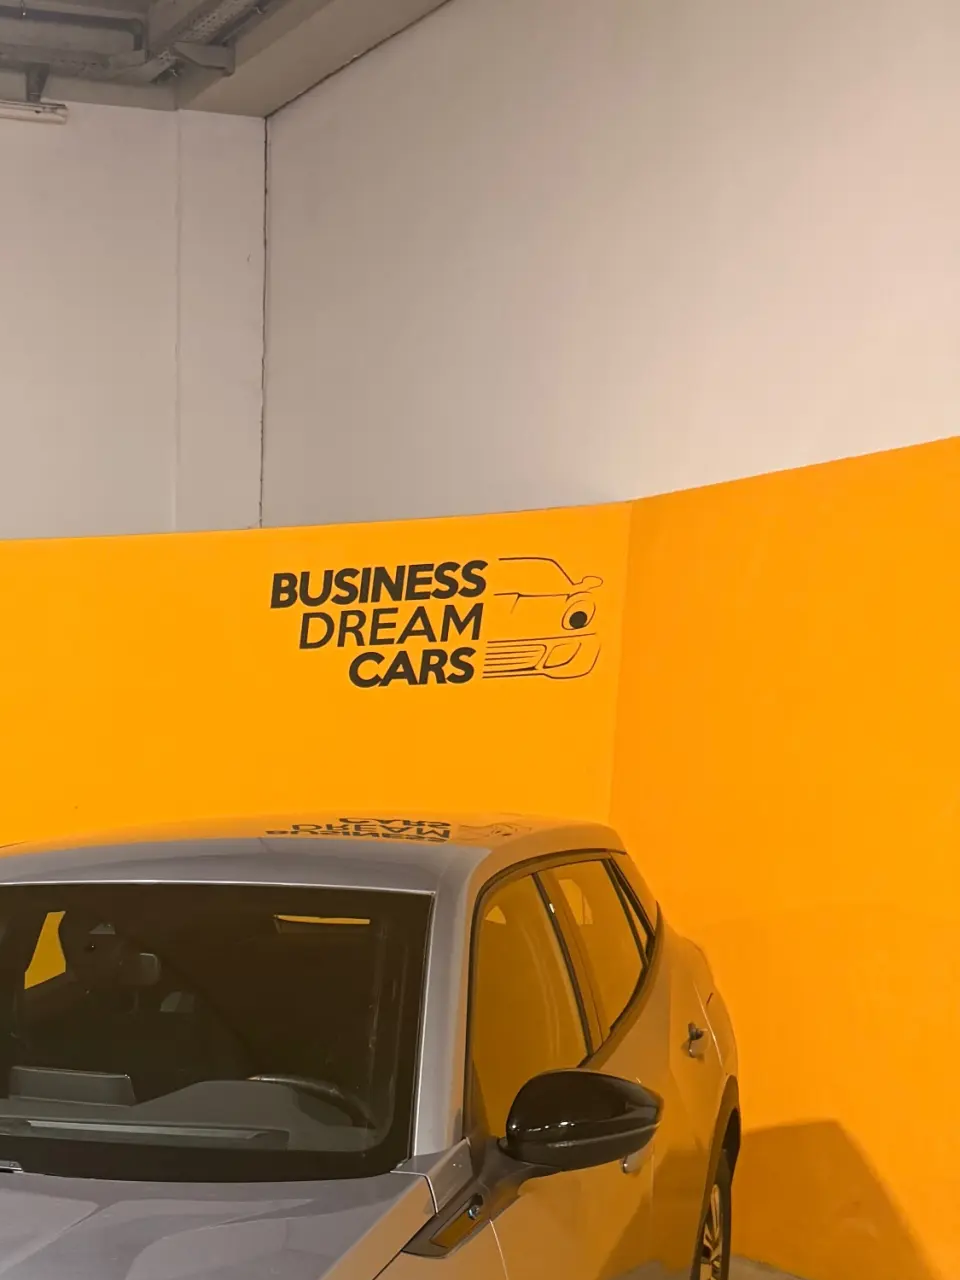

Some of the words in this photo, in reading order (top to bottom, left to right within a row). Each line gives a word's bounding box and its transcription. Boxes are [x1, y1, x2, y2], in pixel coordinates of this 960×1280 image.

[270, 560, 488, 609] BUSINESS
[299, 603, 483, 650] DREAM
[348, 647, 476, 688] CARS
